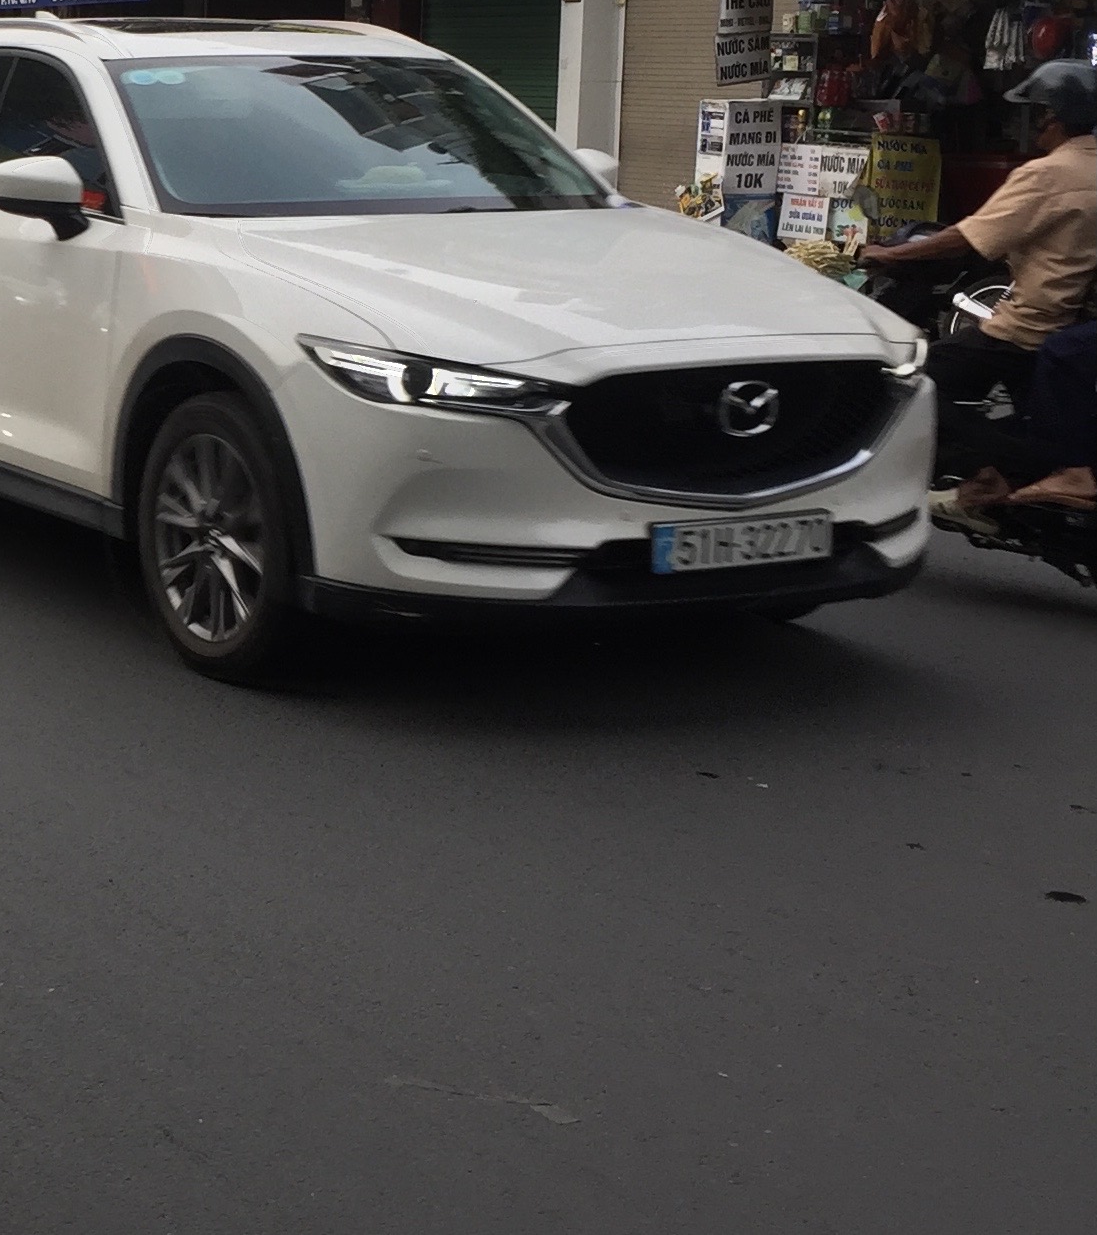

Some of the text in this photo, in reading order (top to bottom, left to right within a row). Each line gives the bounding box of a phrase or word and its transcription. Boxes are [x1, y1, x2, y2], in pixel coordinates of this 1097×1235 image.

[717, 39, 745, 56] NƯỚC
[720, 59, 769, 80] NƯỚC MÍA
[753, 109, 774, 123] PHÊ
[729, 131, 776, 145] MANG ĐI
[727, 151, 775, 166] NƯỚC MÍA
[820, 153, 845, 172] NƯỚC
[735, 173, 764, 188] 10K
